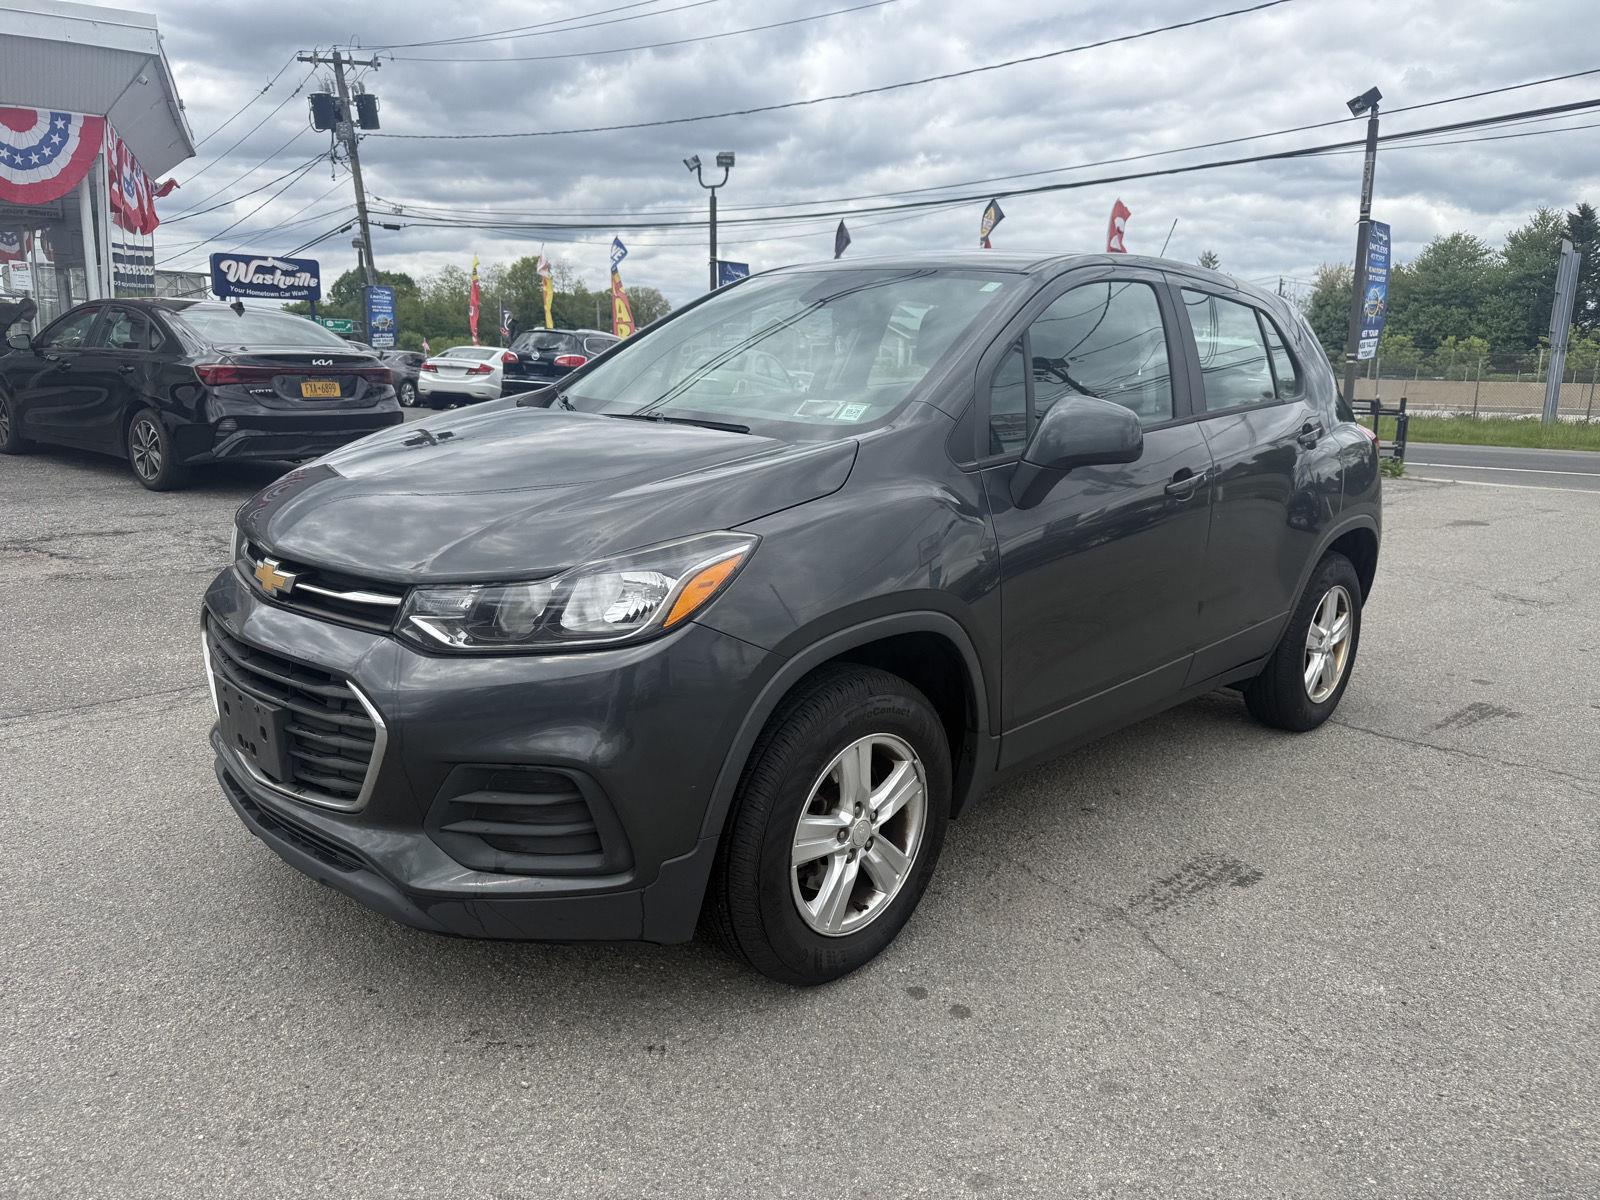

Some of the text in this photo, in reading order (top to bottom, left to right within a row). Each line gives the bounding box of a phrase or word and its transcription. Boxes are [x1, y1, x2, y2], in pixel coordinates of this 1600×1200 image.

[219, 257, 318, 289] Washville
[229, 285, 245, 294] Your
[246, 288, 280, 297] Hometown
[292, 289, 309, 297] Wash
